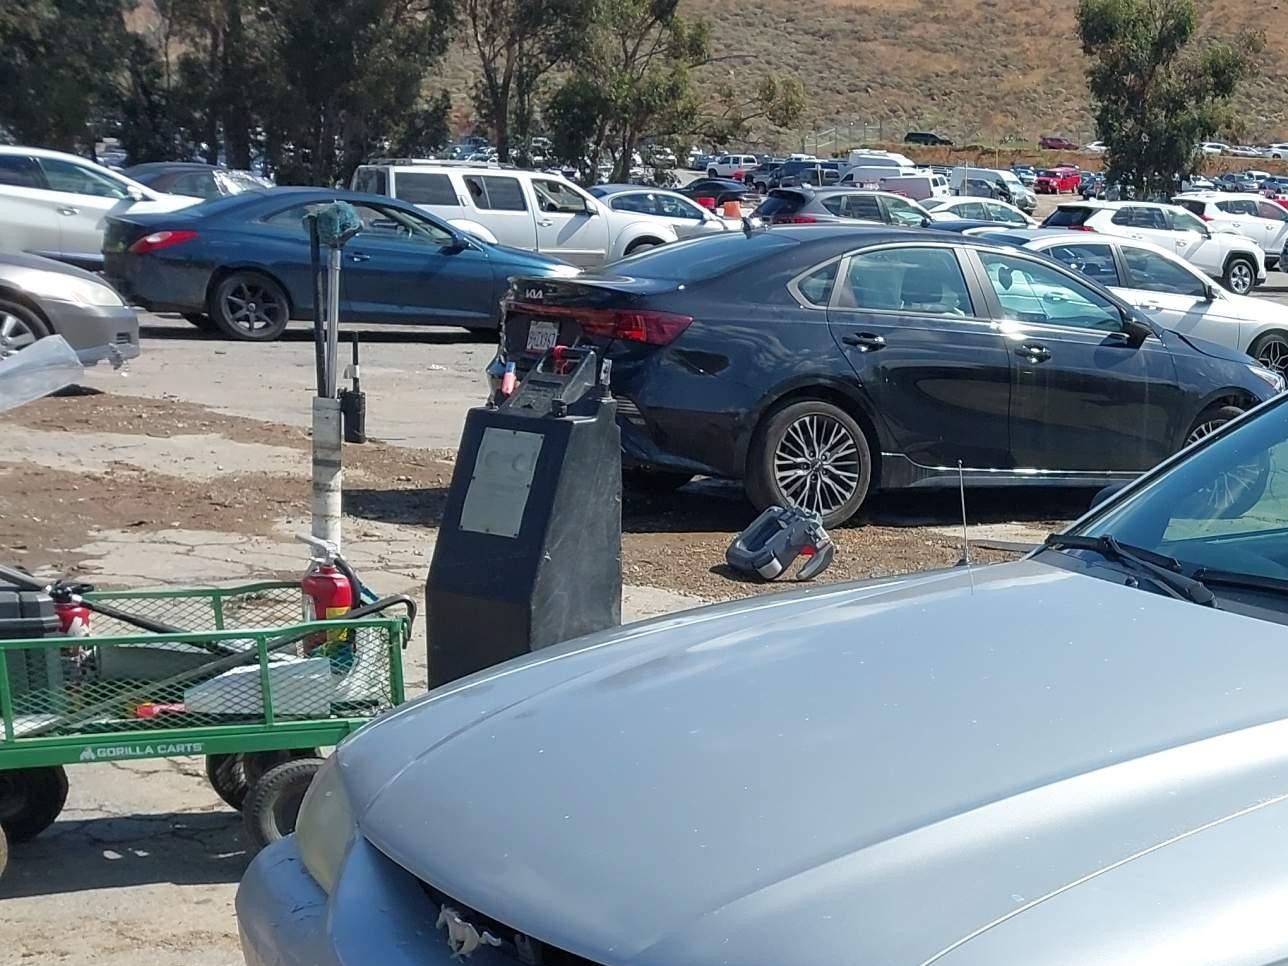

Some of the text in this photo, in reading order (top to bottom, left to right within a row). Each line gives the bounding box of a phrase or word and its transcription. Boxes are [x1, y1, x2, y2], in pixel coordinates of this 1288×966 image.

[525, 288, 544, 299] KIA
[97, 742, 203, 758] GORILLA CARTS
